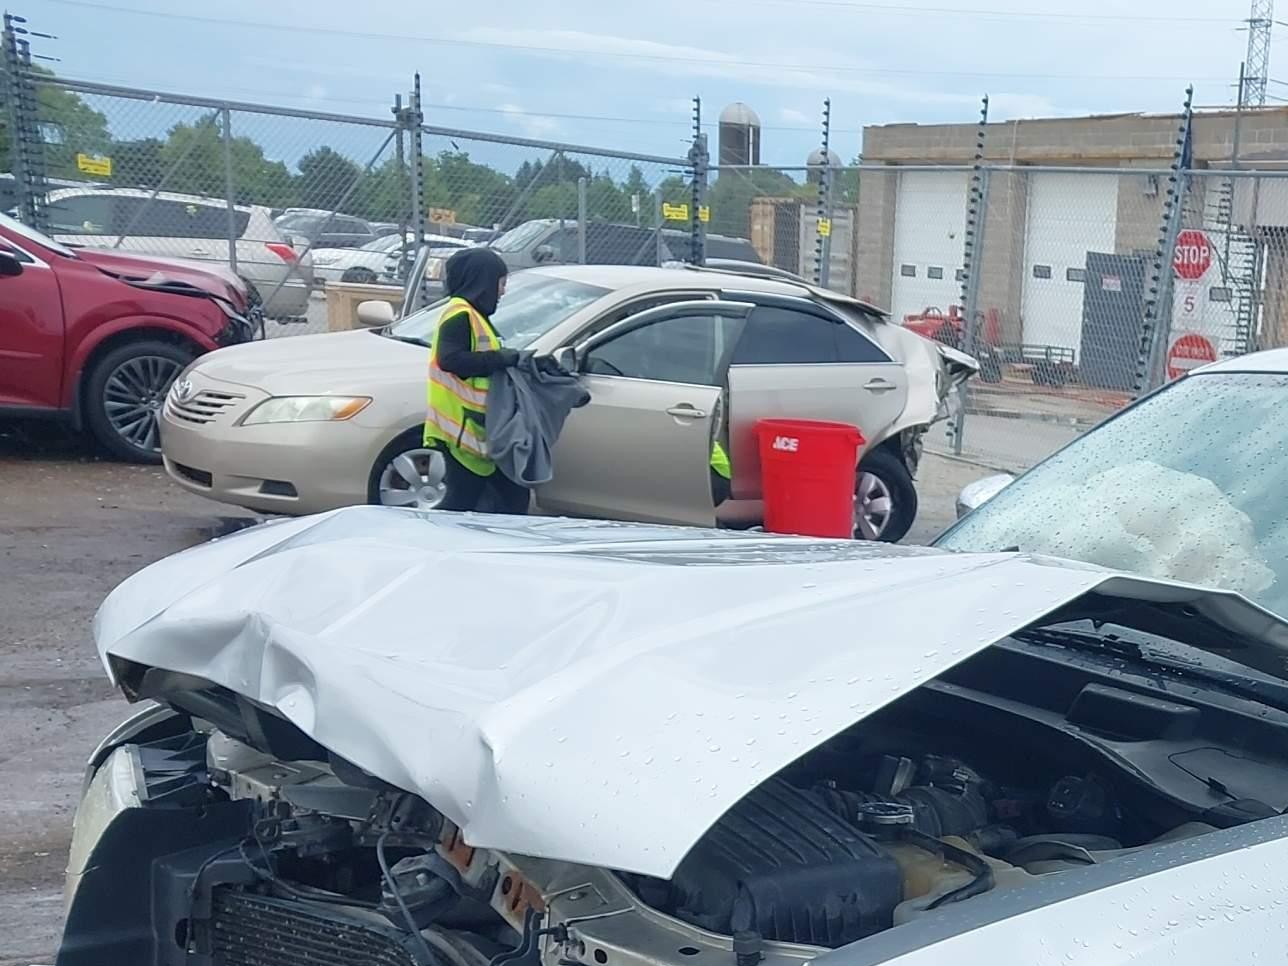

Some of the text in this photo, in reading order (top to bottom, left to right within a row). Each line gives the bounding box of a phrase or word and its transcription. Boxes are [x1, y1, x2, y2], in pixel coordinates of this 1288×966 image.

[1174, 245, 1209, 265] STOP
[1183, 296, 1195, 312] 5
[772, 435, 799, 452] ACE
